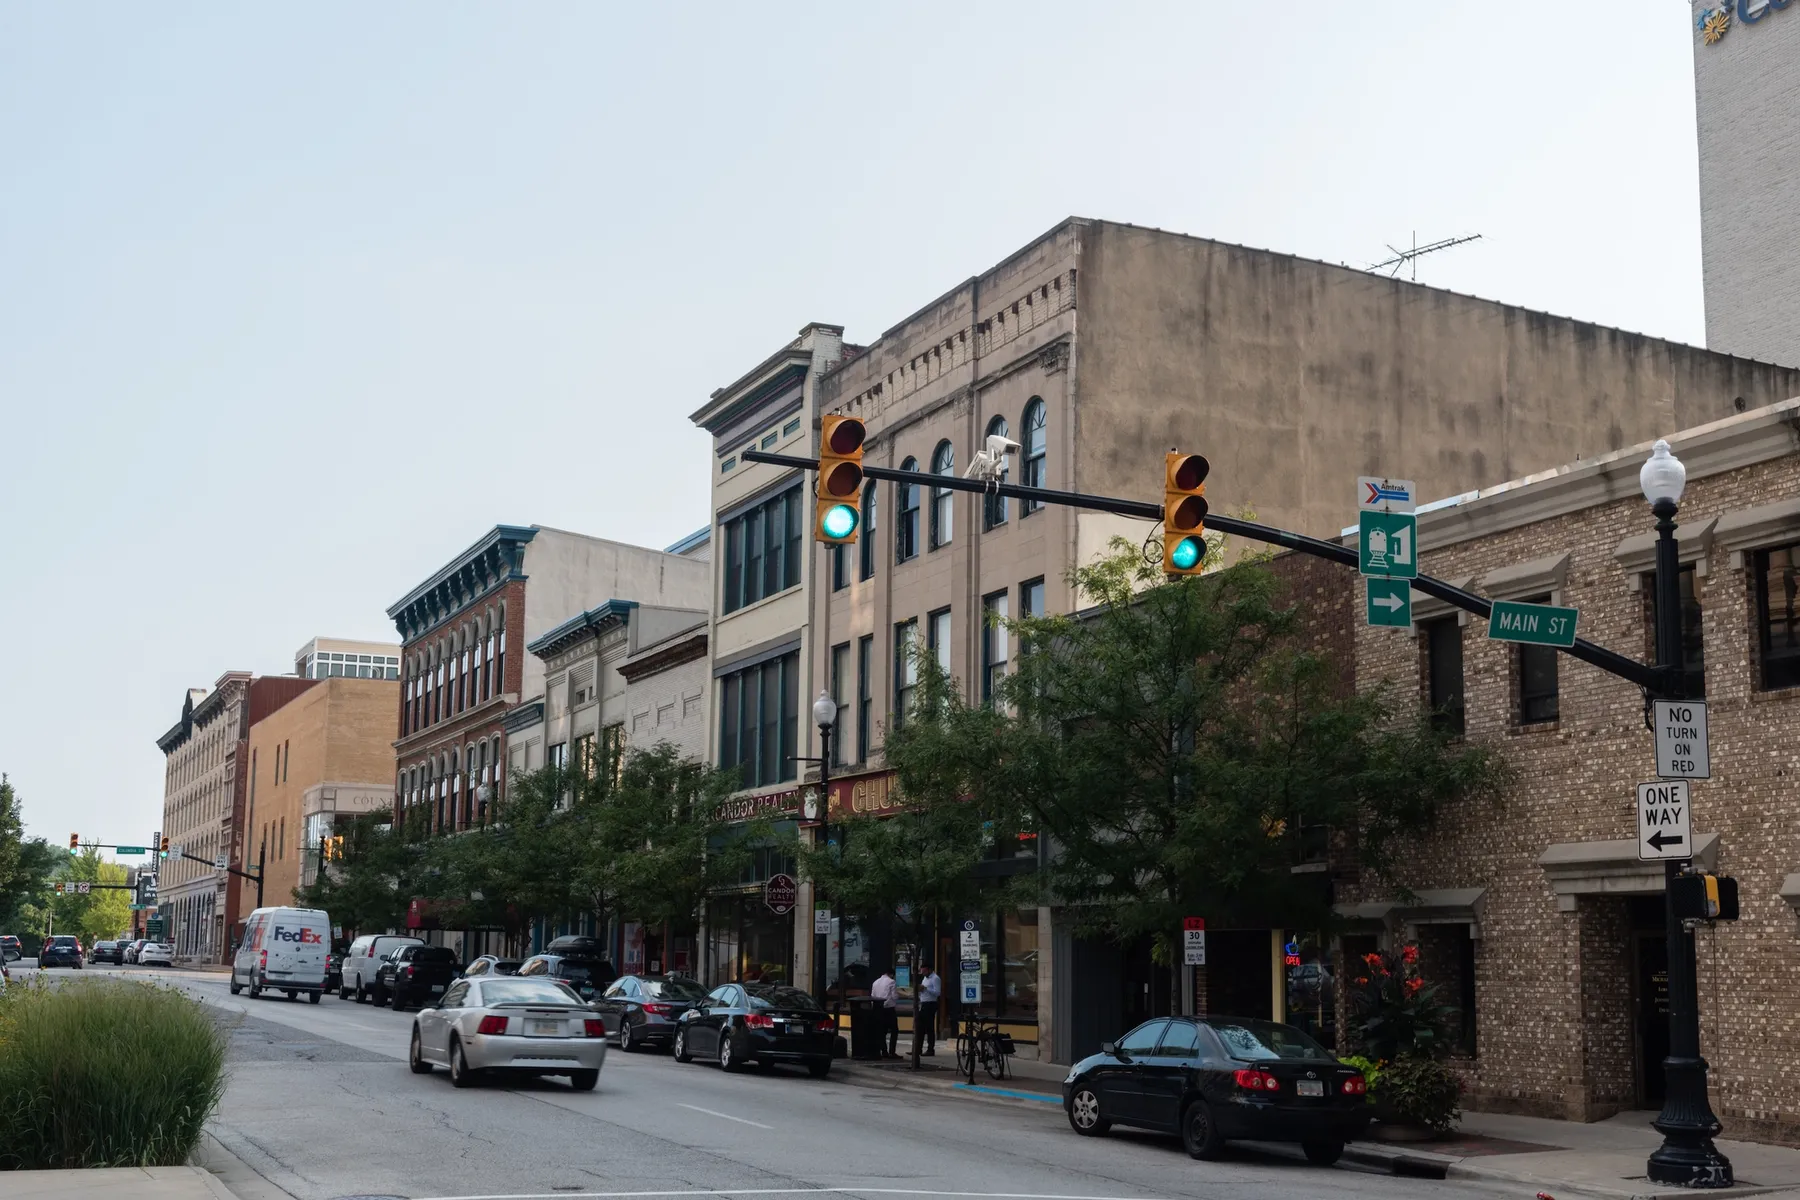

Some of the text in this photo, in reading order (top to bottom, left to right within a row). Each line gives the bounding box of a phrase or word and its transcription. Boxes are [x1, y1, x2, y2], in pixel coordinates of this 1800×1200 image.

[1381, 482, 1406, 492] Amtrak
[1499, 611, 1568, 635] MAIN ST
[1669, 707, 1693, 723] NO
[1666, 726, 1698, 740] TURN
[1674, 743, 1691, 756] ON
[1671, 760, 1695, 773] RED
[1645, 786, 1681, 805] ONE
[715, 799, 754, 821] CANDOR
[1645, 807, 1682, 826] WAY
[1188, 919, 1201, 929] LZ
[274, 925, 323, 945] FedEx
[967, 931, 973, 939] 2
[1189, 931, 1200, 940] 30
[1285, 955, 1301, 966] OPEN
